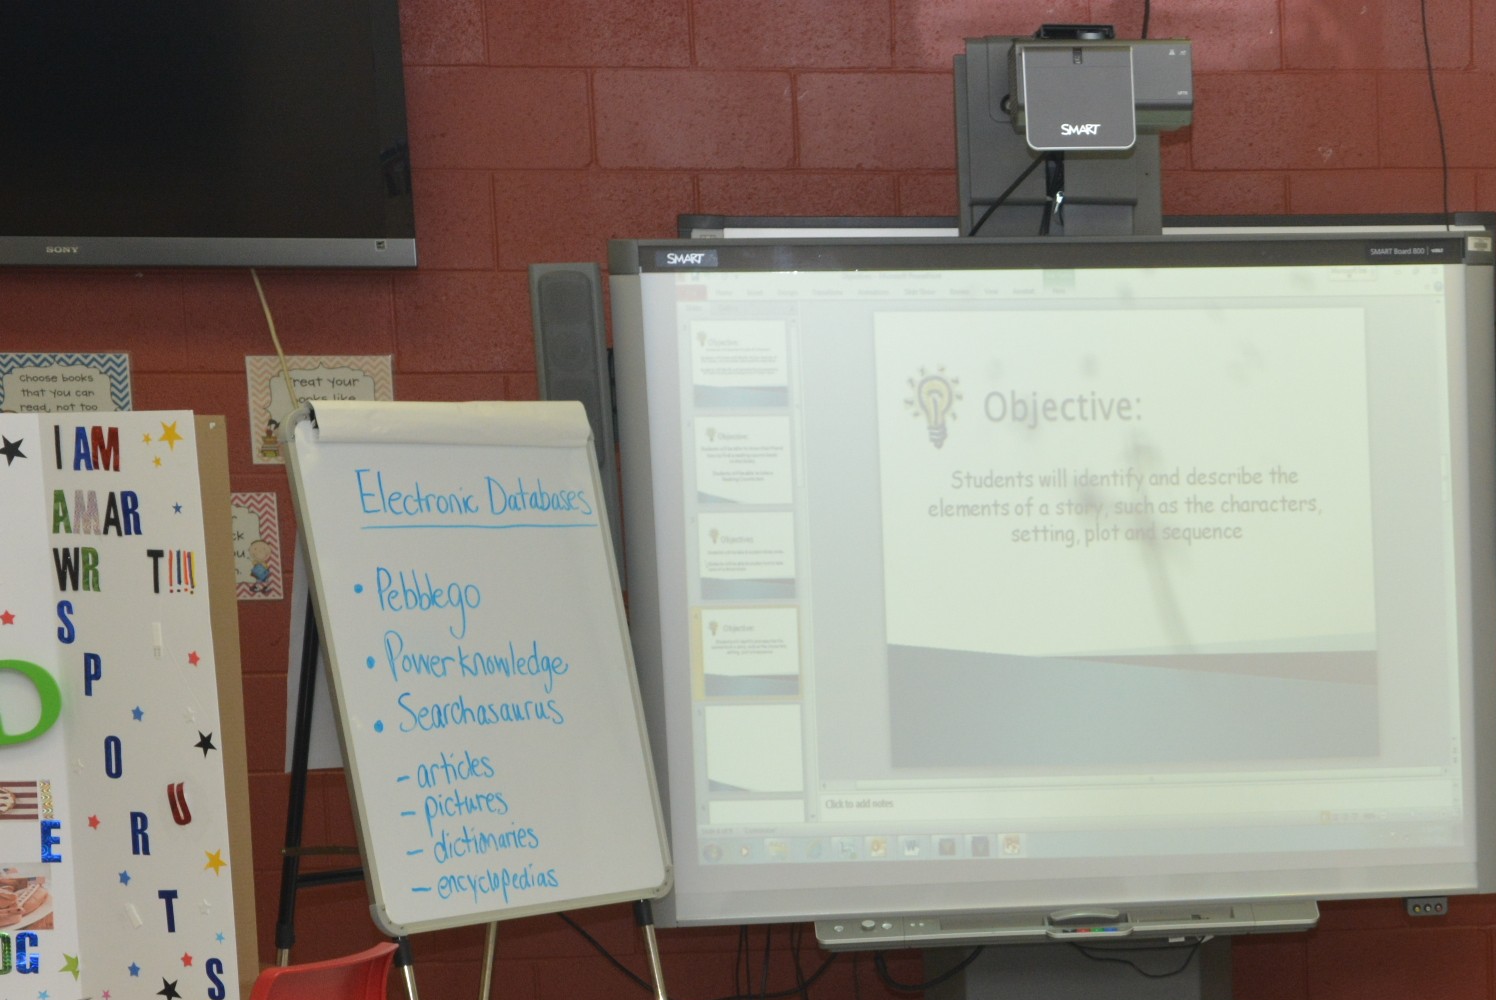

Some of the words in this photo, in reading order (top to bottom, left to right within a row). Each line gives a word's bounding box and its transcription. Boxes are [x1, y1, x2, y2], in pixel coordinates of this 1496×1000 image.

[1061, 123, 1101, 136] SMART
[46, 246, 78, 254] SONY
[666, 252, 705, 264] SMART
[1394, 247, 1411, 255] Board
[62, 373, 94, 383] books
[293, 377, 322, 388] reat
[327, 377, 359, 389] your
[21, 388, 46, 397] that
[51, 388, 71, 398] you
[75, 389, 94, 397] can
[57, 403, 75, 411] not
[81, 403, 97, 411] too
[984, 389, 1142, 430] Objective:
[73, 425, 120, 471] AM
[951, 468, 1034, 490] Students
[1039, 467, 1068, 489] will
[1073, 466, 1144, 492] identify
[1148, 466, 1181, 487] and
[1186, 465, 1264, 487] describe
[1269, 465, 1299, 485] the
[355, 468, 479, 516] Electronic
[484, 475, 593, 516] Databases
[52, 490, 142, 537] AMAR
[927, 497, 1010, 517] elements
[1014, 496, 1034, 517] of
[1038, 501, 1050, 516] a
[1114, 494, 1155, 515] such
[1158, 499, 1179, 515] as
[1183, 494, 1215, 515] the
[1220, 493, 1323, 516] characters,
[1011, 524, 1081, 548] setting,
[1084, 523, 1120, 548] plot
[1161, 524, 1244, 548] sequence
[53, 547, 101, 592] WR
[397, 692, 565, 733] Searchasaurus
